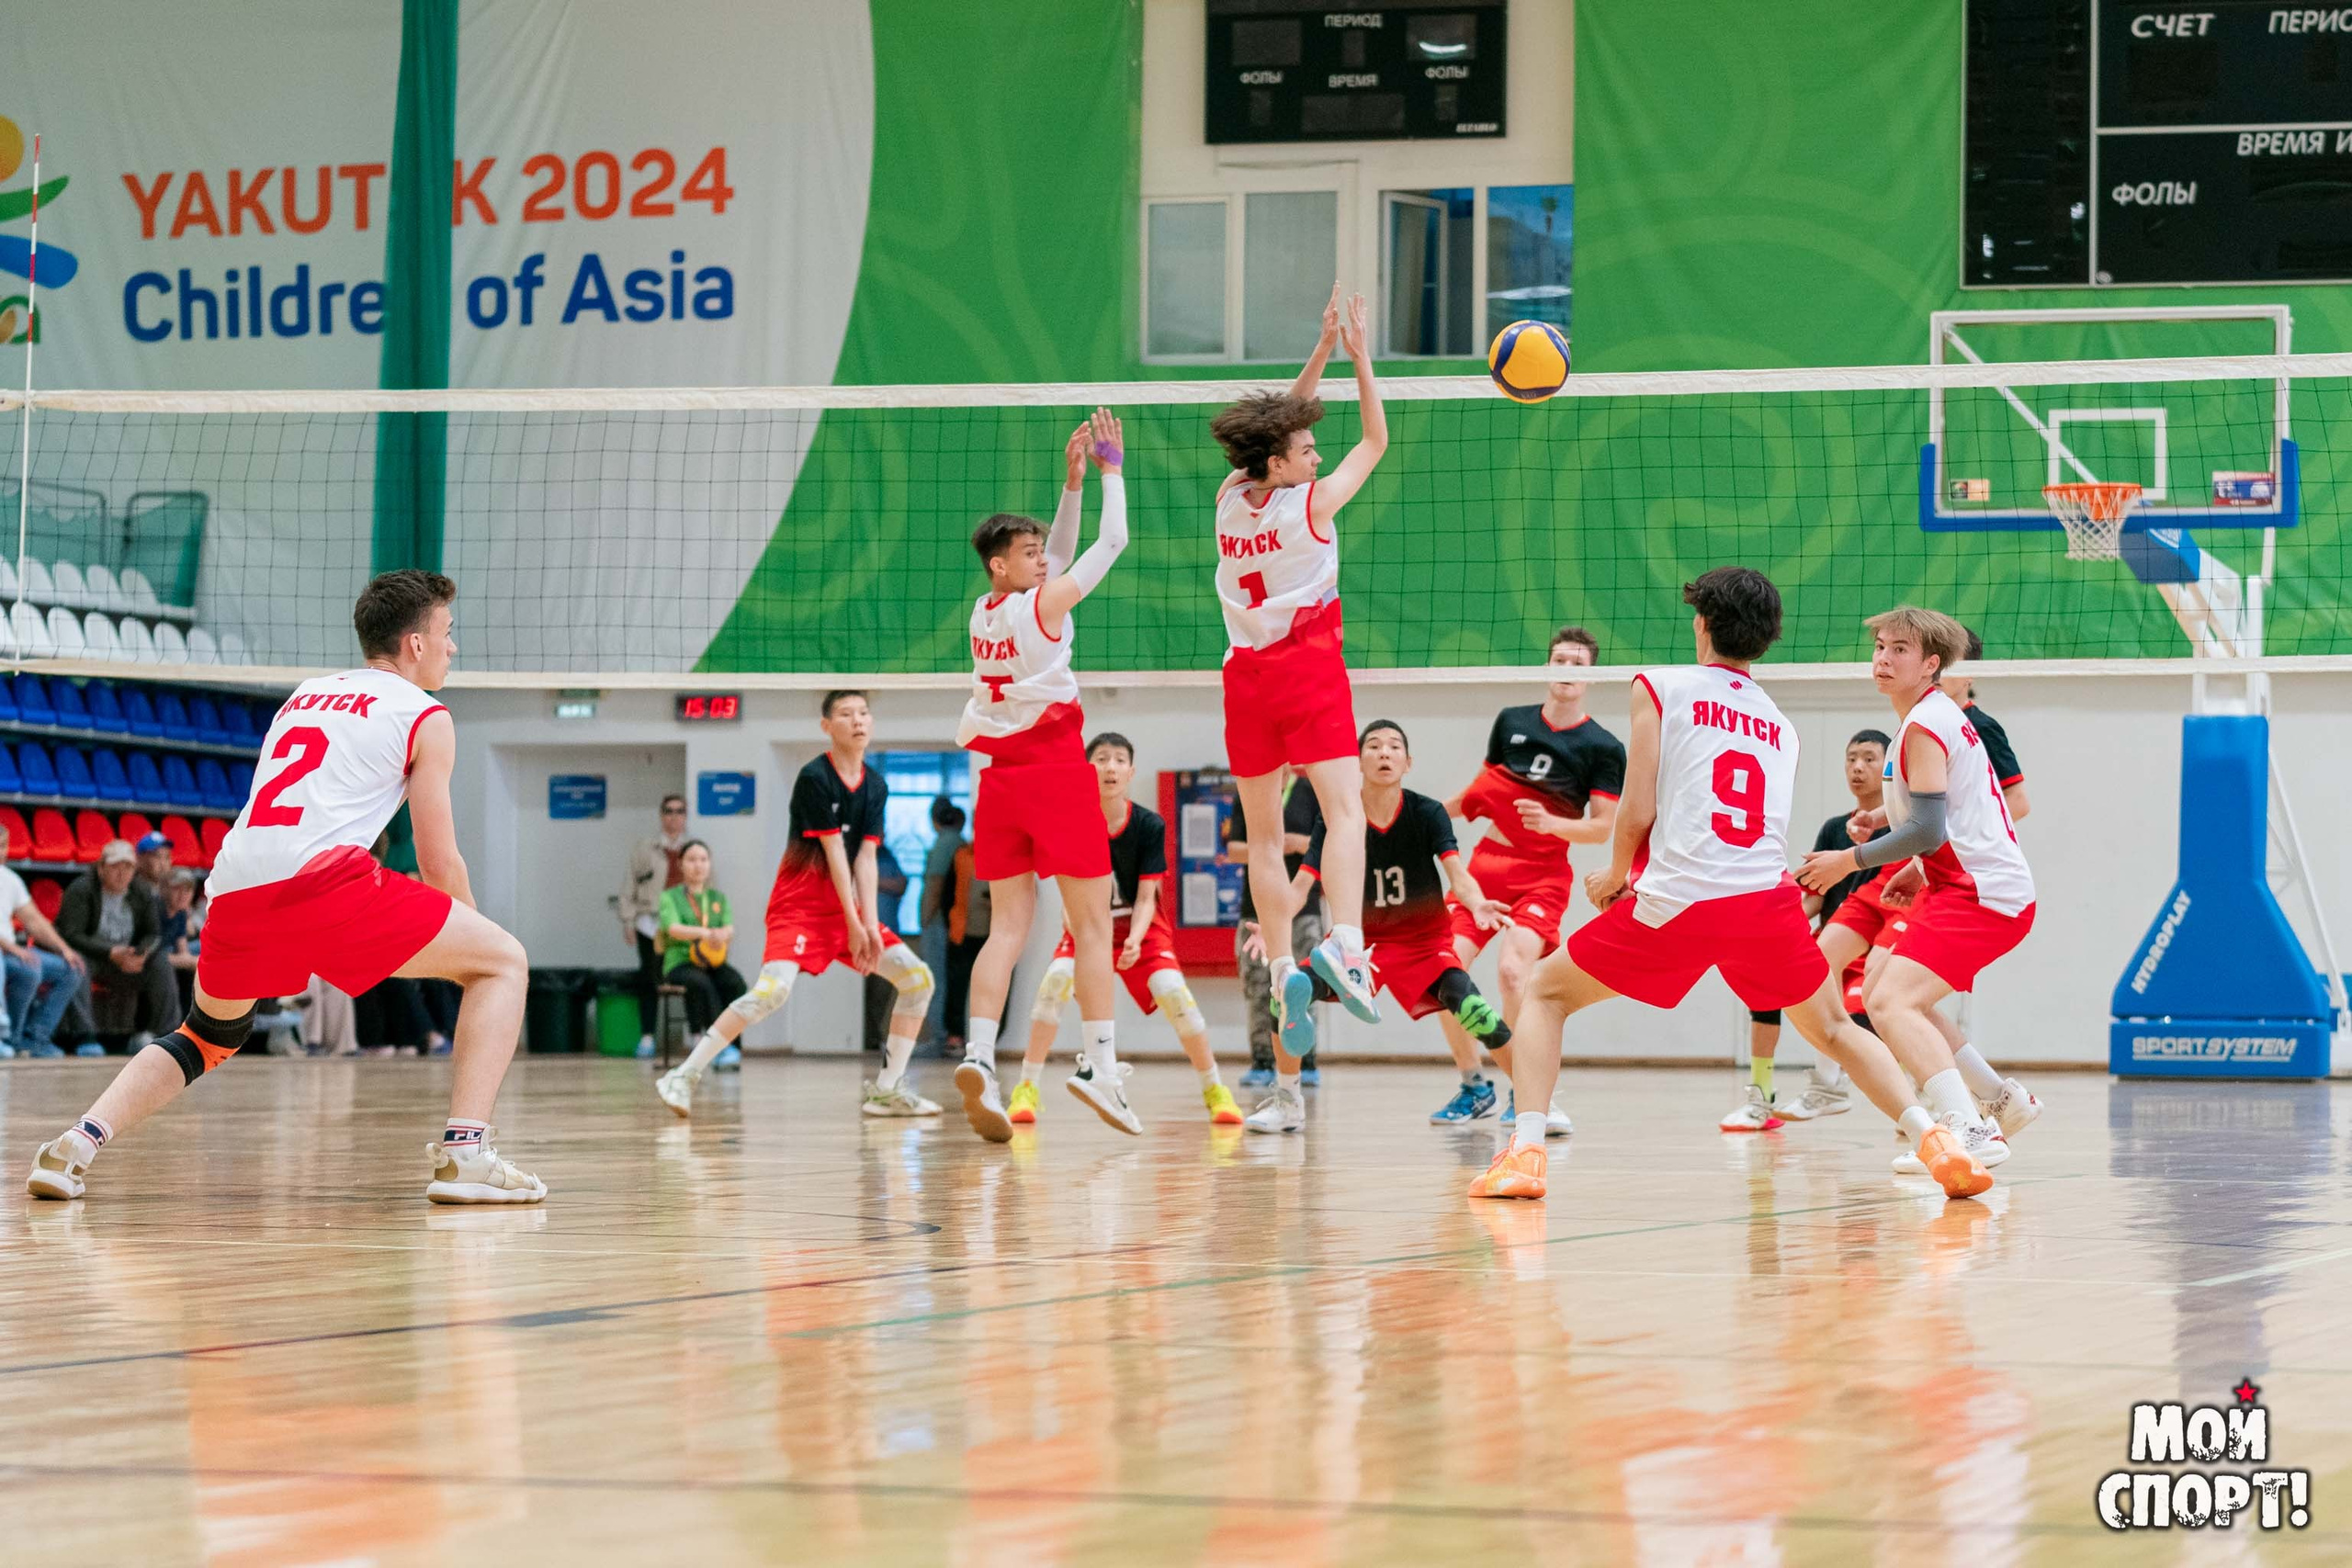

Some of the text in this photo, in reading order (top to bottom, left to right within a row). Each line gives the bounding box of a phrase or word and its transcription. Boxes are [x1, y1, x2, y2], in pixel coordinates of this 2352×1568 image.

[1324, 14, 1383, 28] ПЕРИОД
[2130, 13, 2215, 39] СЧЕТ
[1328, 73, 1378, 88] ВРЕМЯ
[2236, 131, 2326, 156] ВРЕМЯ
[122, 146, 734, 239] YAKUTK 2024
[2111, 181, 2198, 207] ФОЛЫ
[123, 249, 734, 343] Childre of Asia
[1692, 701, 1781, 751] ЯКУТСК
[246, 726, 330, 829] 2
[1711, 749, 1766, 849] 9
[1373, 866, 1406, 908] 13
[2131, 889, 2192, 995] HYDROPLAY
